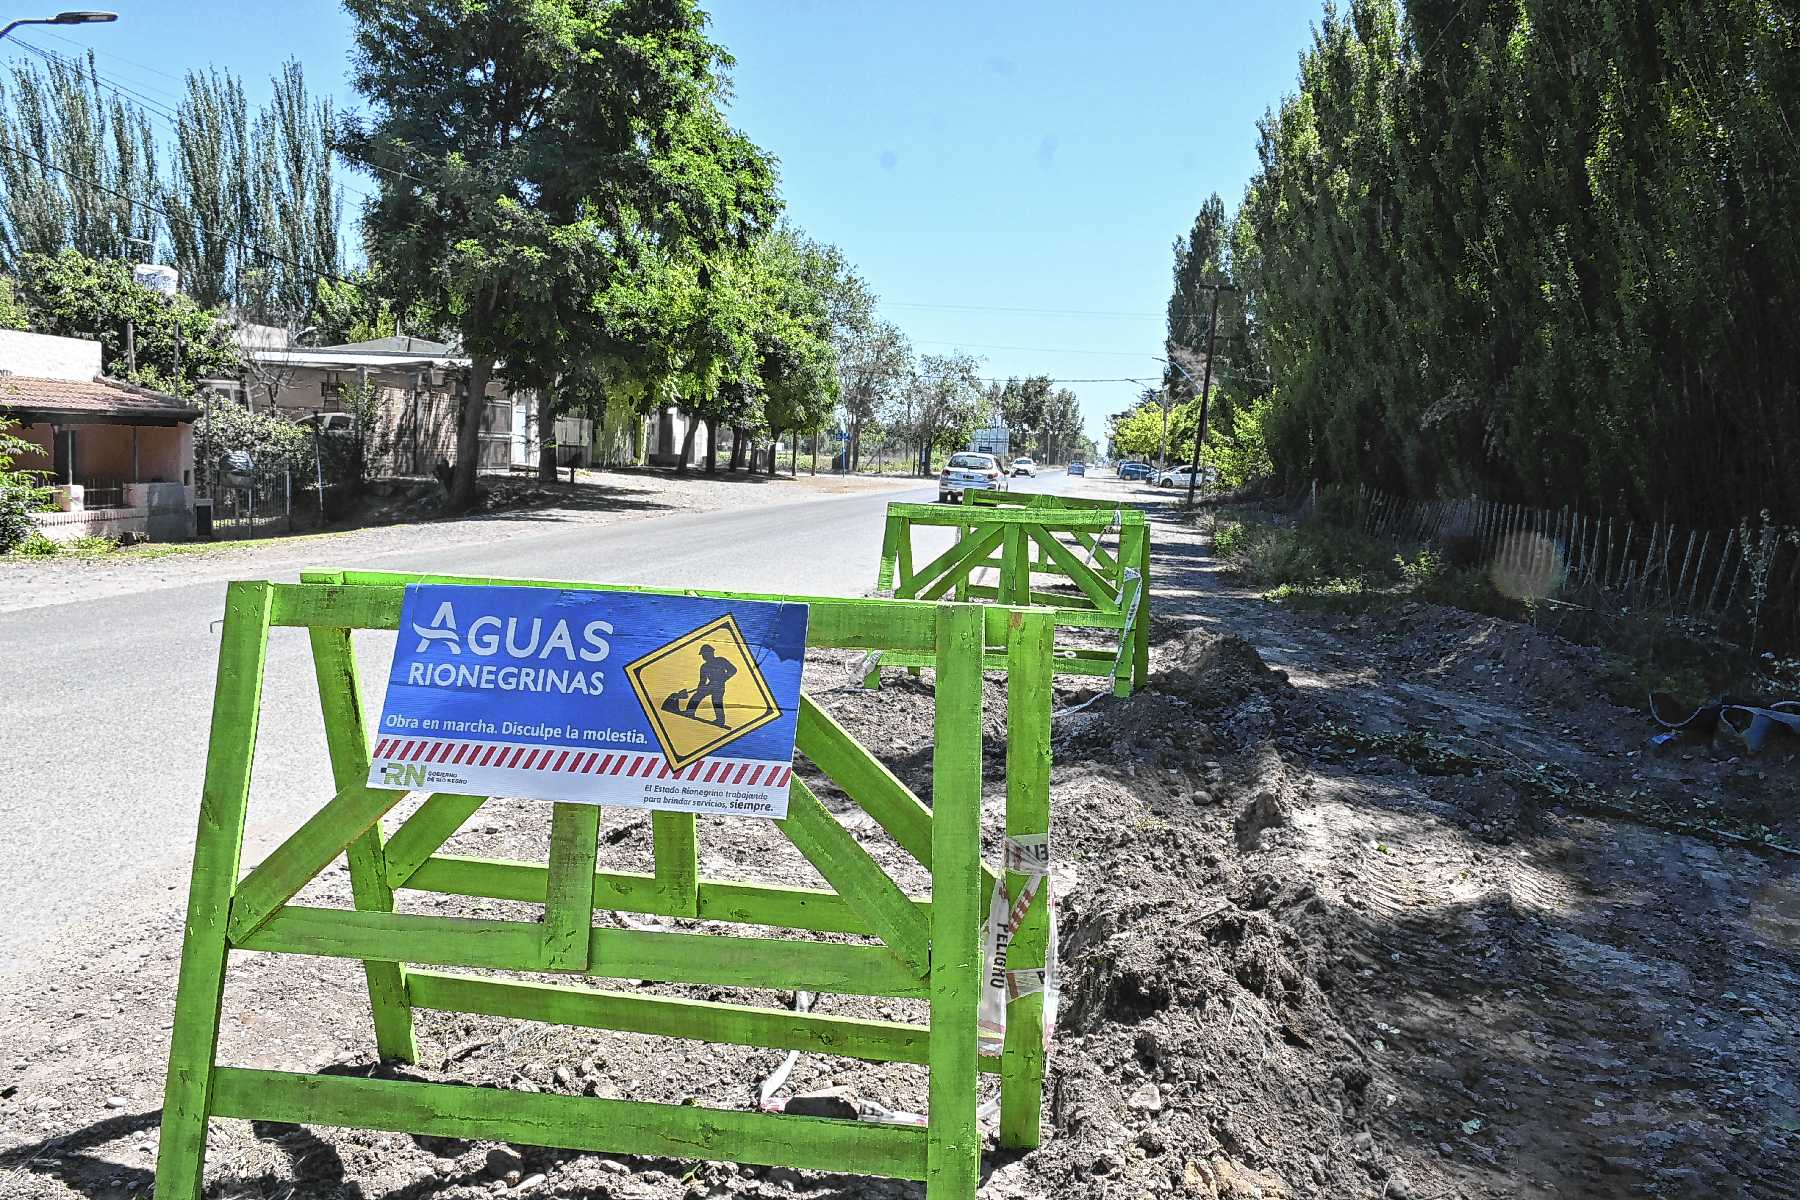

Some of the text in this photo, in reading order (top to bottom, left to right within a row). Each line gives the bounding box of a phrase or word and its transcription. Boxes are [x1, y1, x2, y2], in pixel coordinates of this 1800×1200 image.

[413, 601, 614, 662] AGUAS
[408, 662, 604, 696] RIONEGRINAS
[386, 714, 648, 745] Obra en marcha. Disculpe la molestia.
[384, 762, 427, 788] RN
[643, 796, 774, 812] para brindar servicios, siempre.
[644, 784, 769, 801] El Estado Rionegrino trabajando
